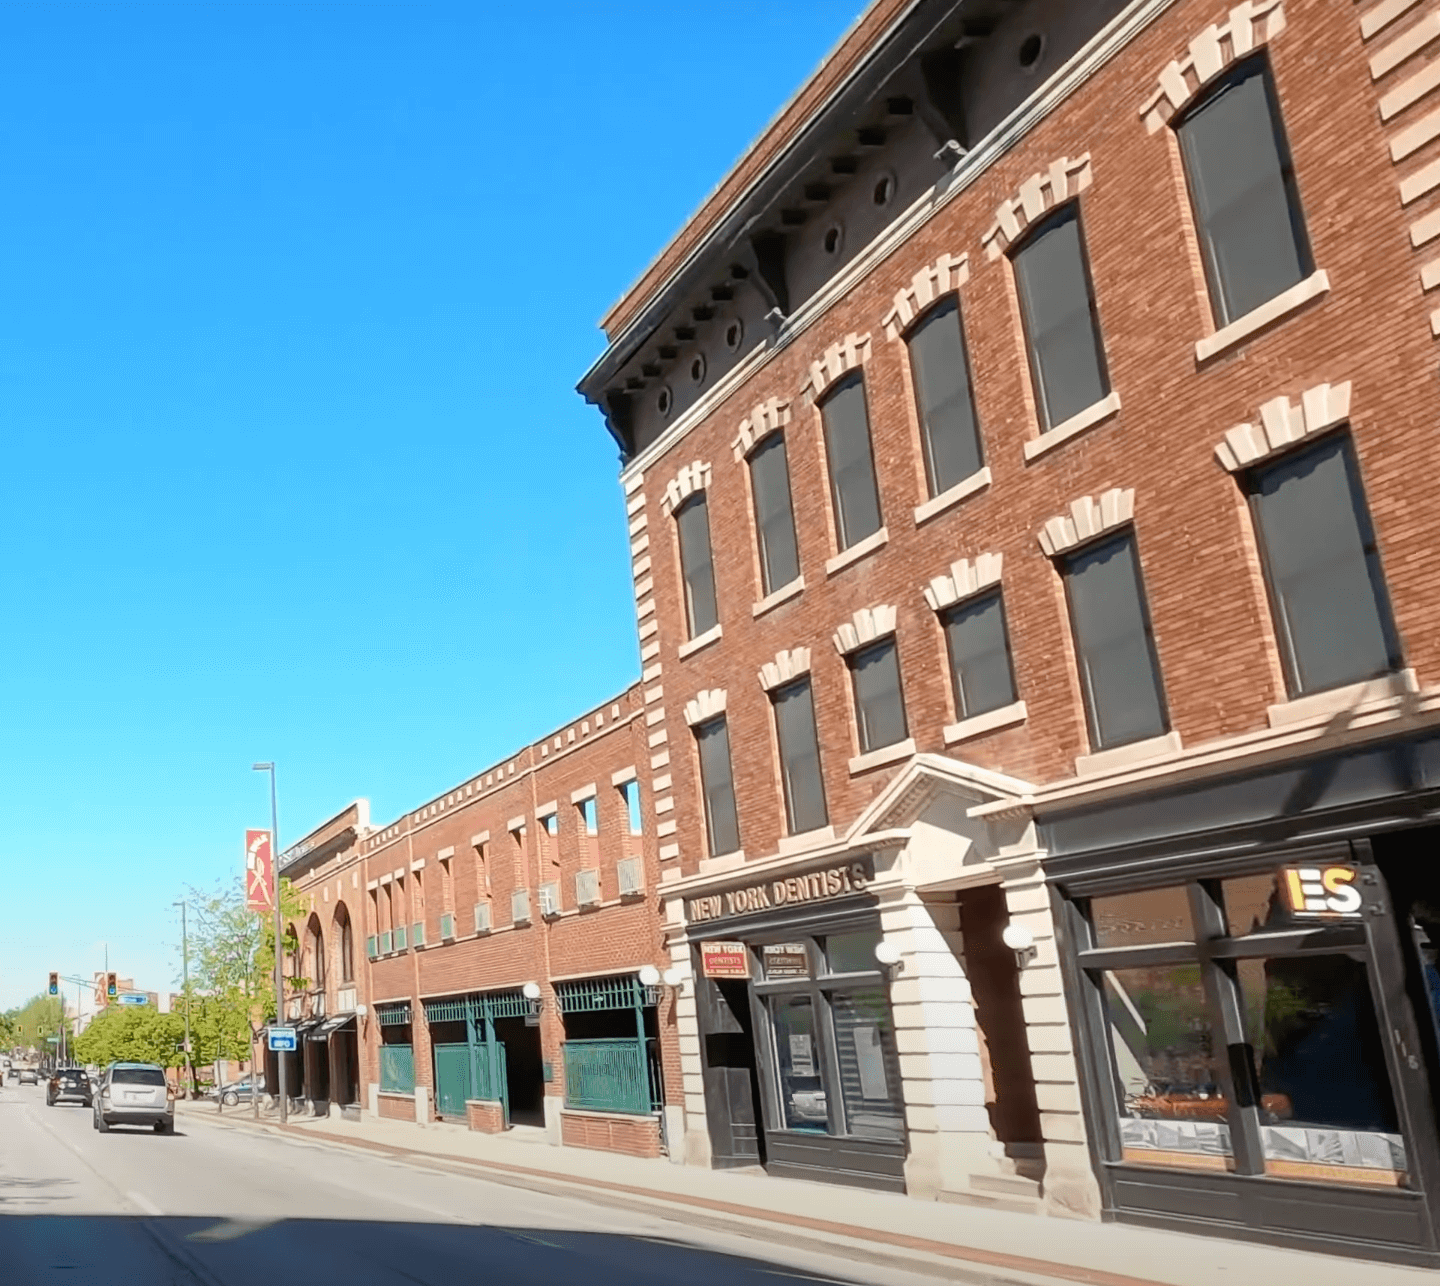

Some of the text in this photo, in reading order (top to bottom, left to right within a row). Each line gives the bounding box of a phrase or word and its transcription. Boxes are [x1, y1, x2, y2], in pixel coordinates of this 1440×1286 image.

[690, 863, 867, 922] NEW YORK DENTISTS
[1284, 867, 1362, 913] ES
[703, 945, 744, 954] NEW YORK
